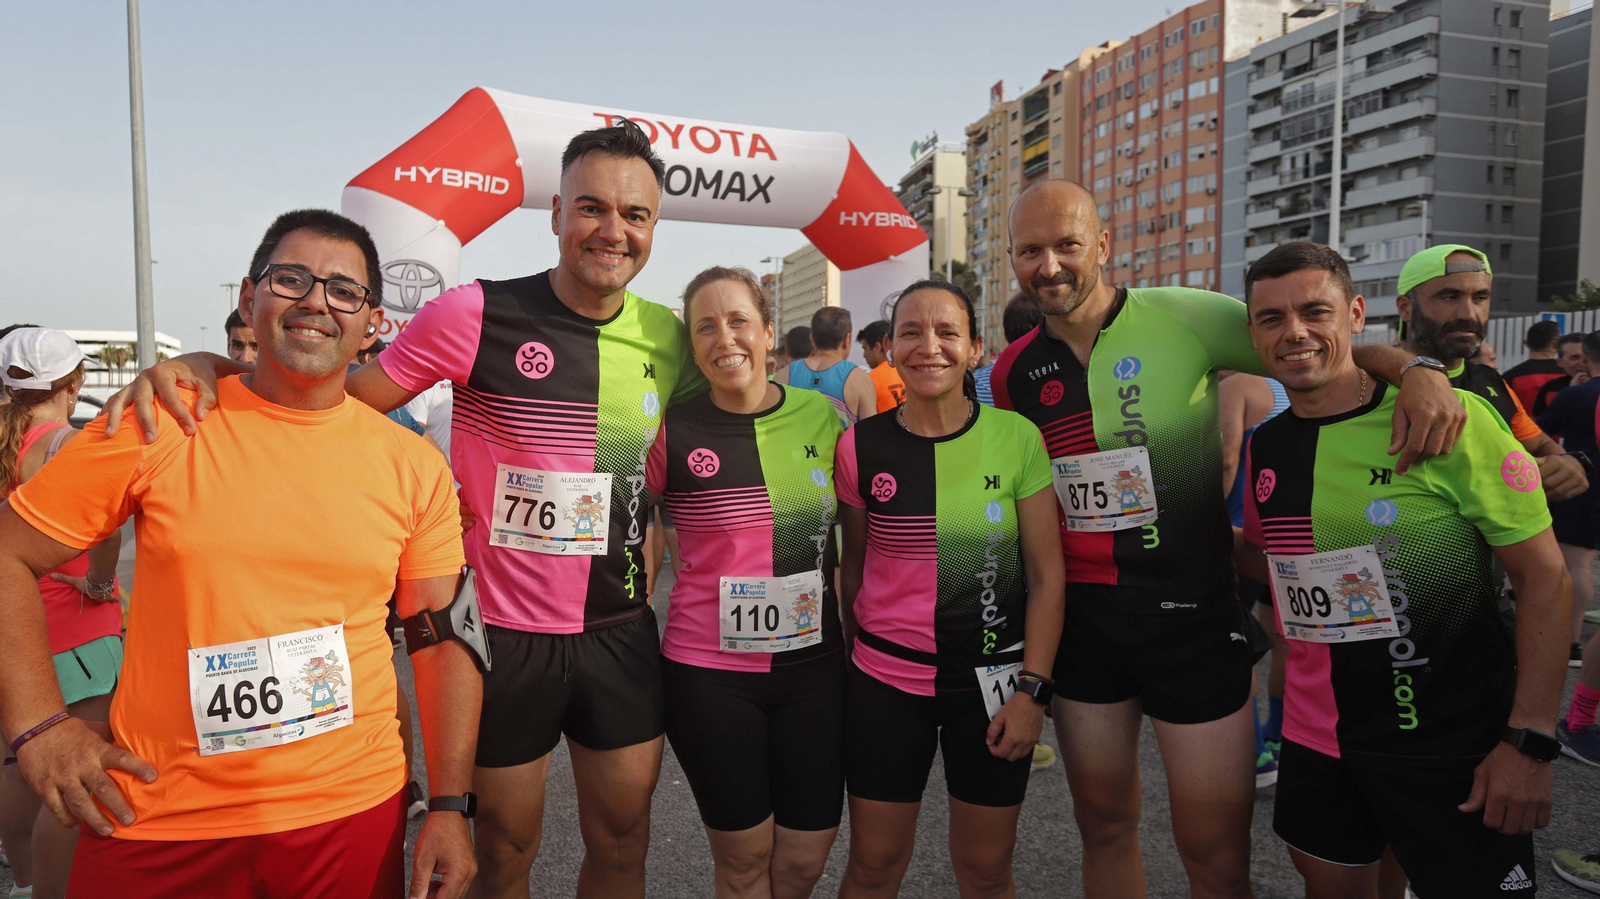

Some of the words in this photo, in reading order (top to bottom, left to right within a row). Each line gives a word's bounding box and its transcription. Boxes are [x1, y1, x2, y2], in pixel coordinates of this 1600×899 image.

[394, 166, 510, 195] HYBRID
[839, 211, 917, 229] HYBRID
[1105, 452, 1133, 461] MANUEL
[506, 472, 522, 486] XX
[522, 474, 544, 483] Carrera
[522, 481, 544, 490] Popular
[1068, 481, 1108, 511] 875
[504, 495, 556, 530] 776
[1310, 554, 1352, 565] FERNANDO
[730, 583, 746, 595] XX
[1287, 585, 1332, 618] 809
[730, 604, 780, 632] 110
[277, 634, 324, 649] FRANCISCO
[205, 653, 229, 672] XX
[227, 650, 256, 660] Carrera
[228, 658, 258, 669] Popular
[207, 676, 284, 723] 466
[273, 729, 297, 739] Algeciras
[1500, 880, 1532, 890] adidas
